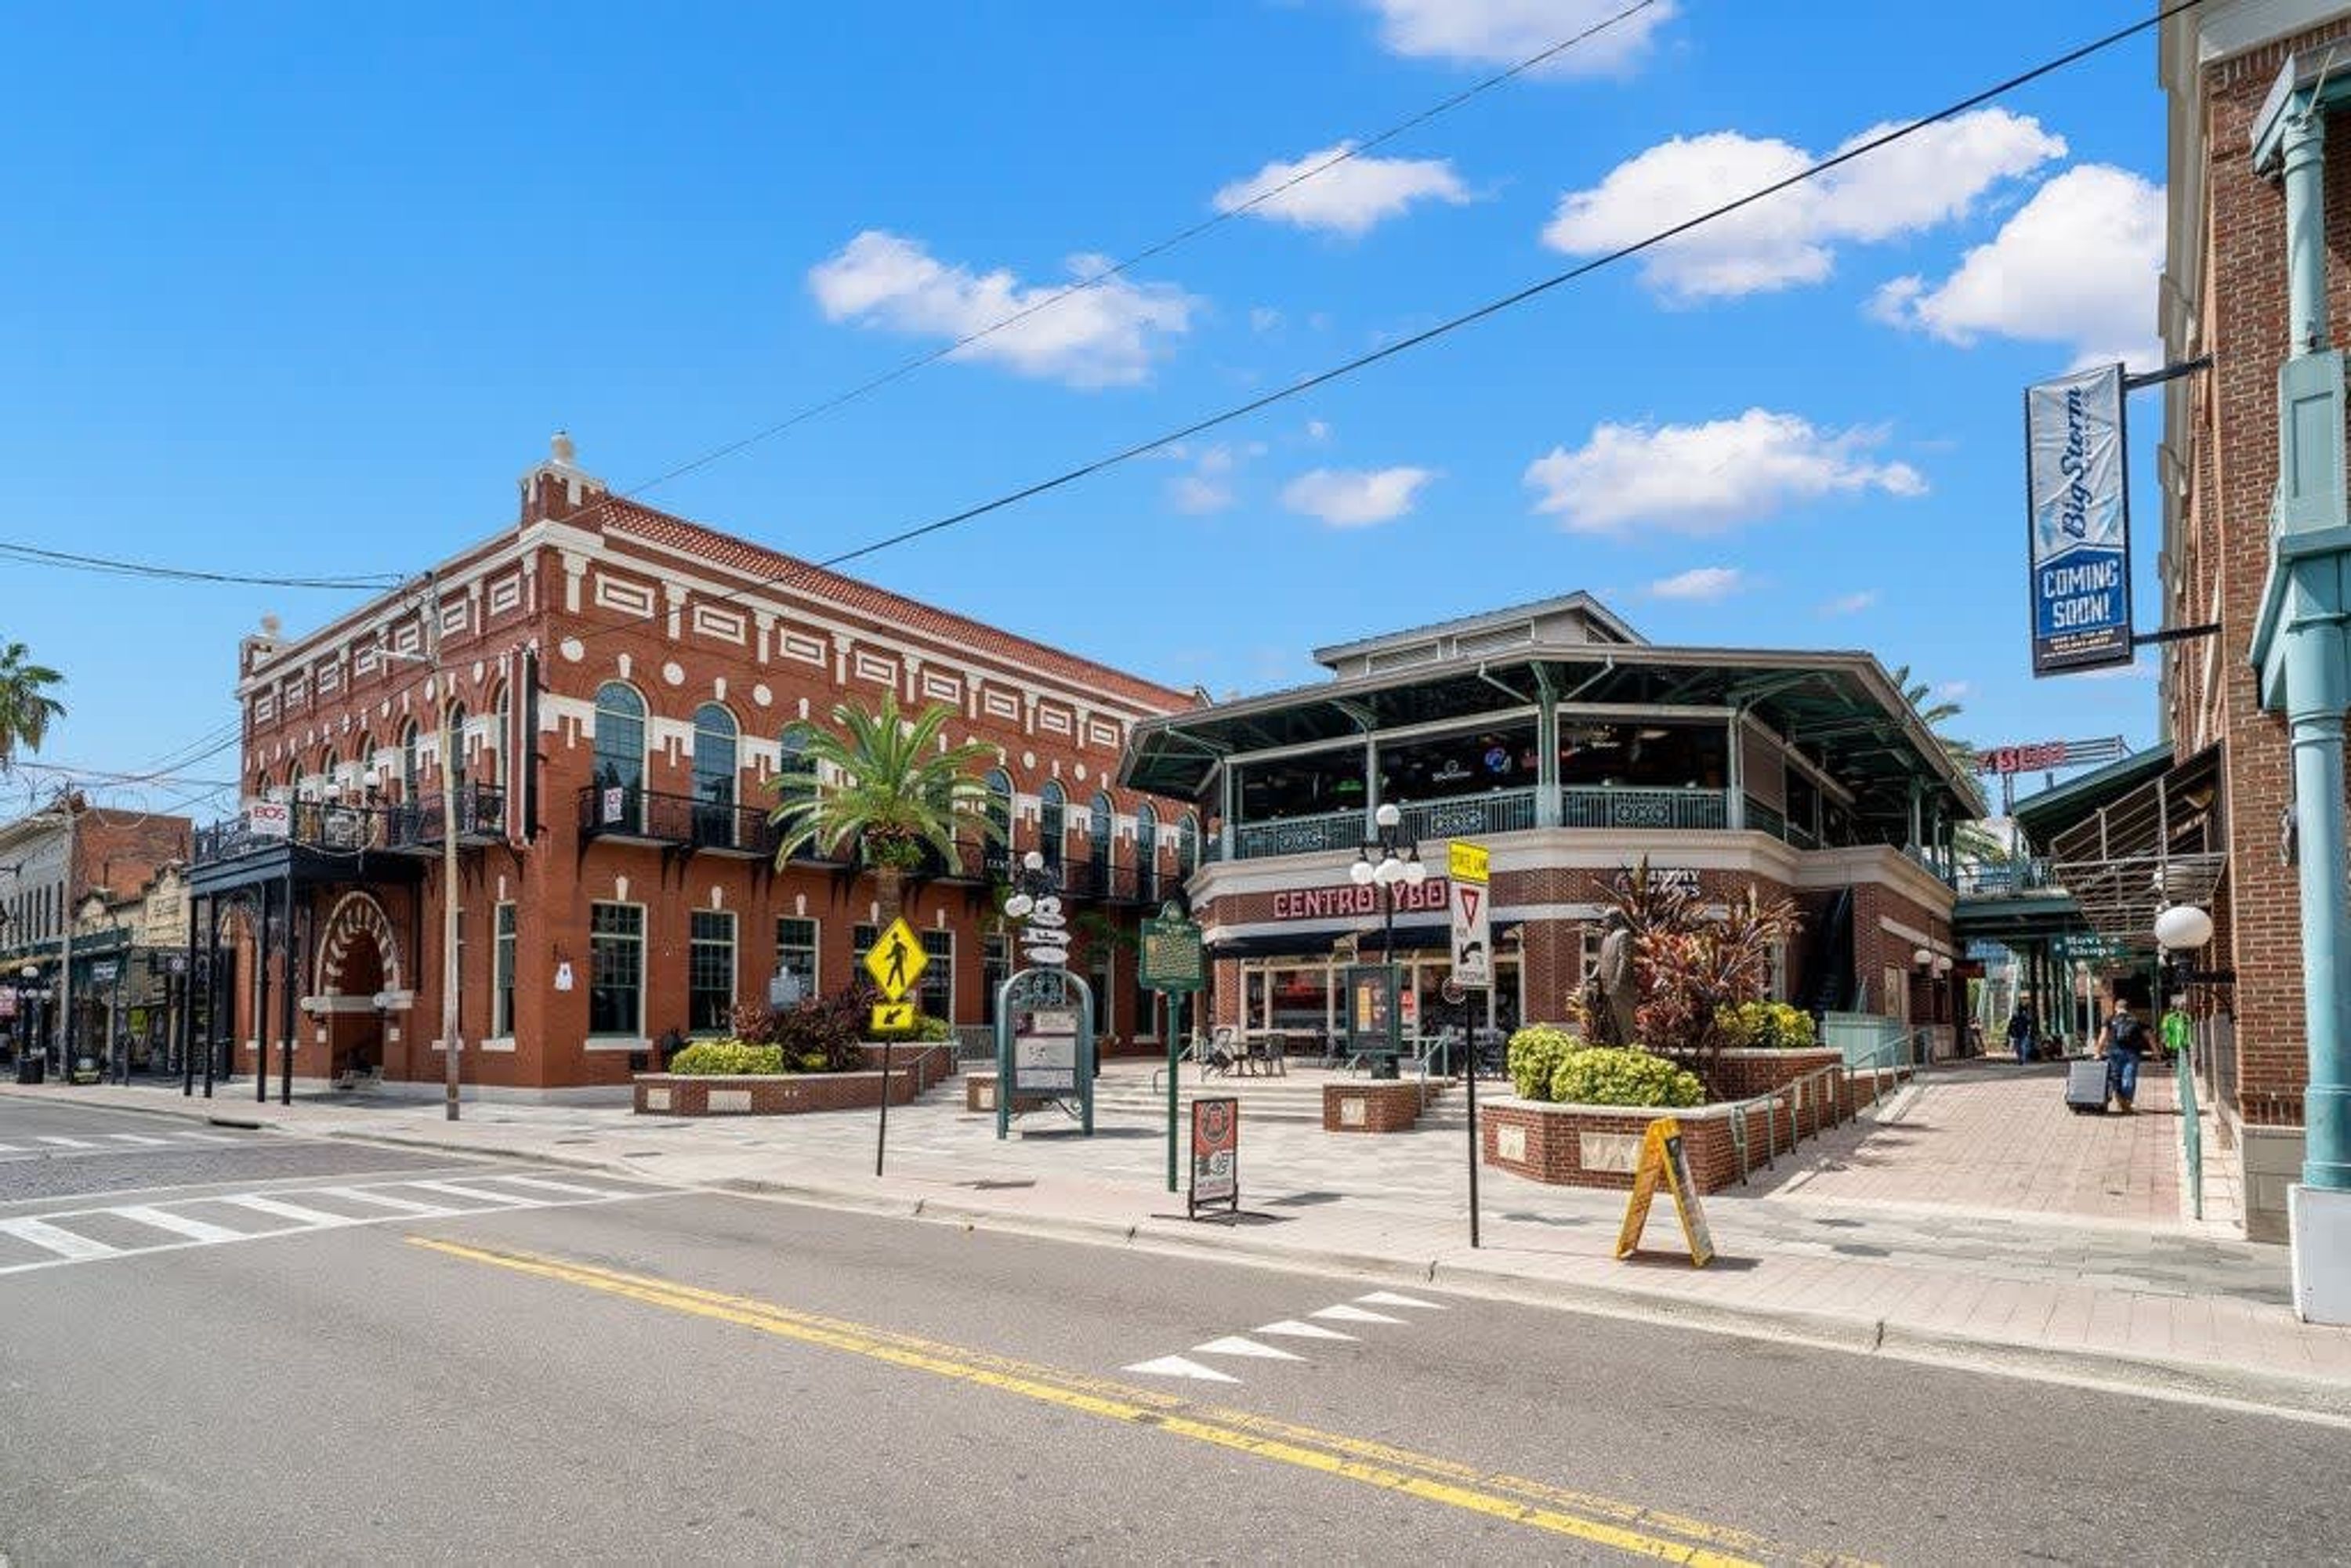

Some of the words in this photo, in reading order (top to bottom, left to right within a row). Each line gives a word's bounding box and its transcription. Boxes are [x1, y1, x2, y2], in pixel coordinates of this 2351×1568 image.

[2043, 559, 2118, 598] COMING
[2052, 592, 2111, 628] SOON!
[1273, 885, 1374, 918] CENTRO
[1391, 880, 1447, 911] YBO
